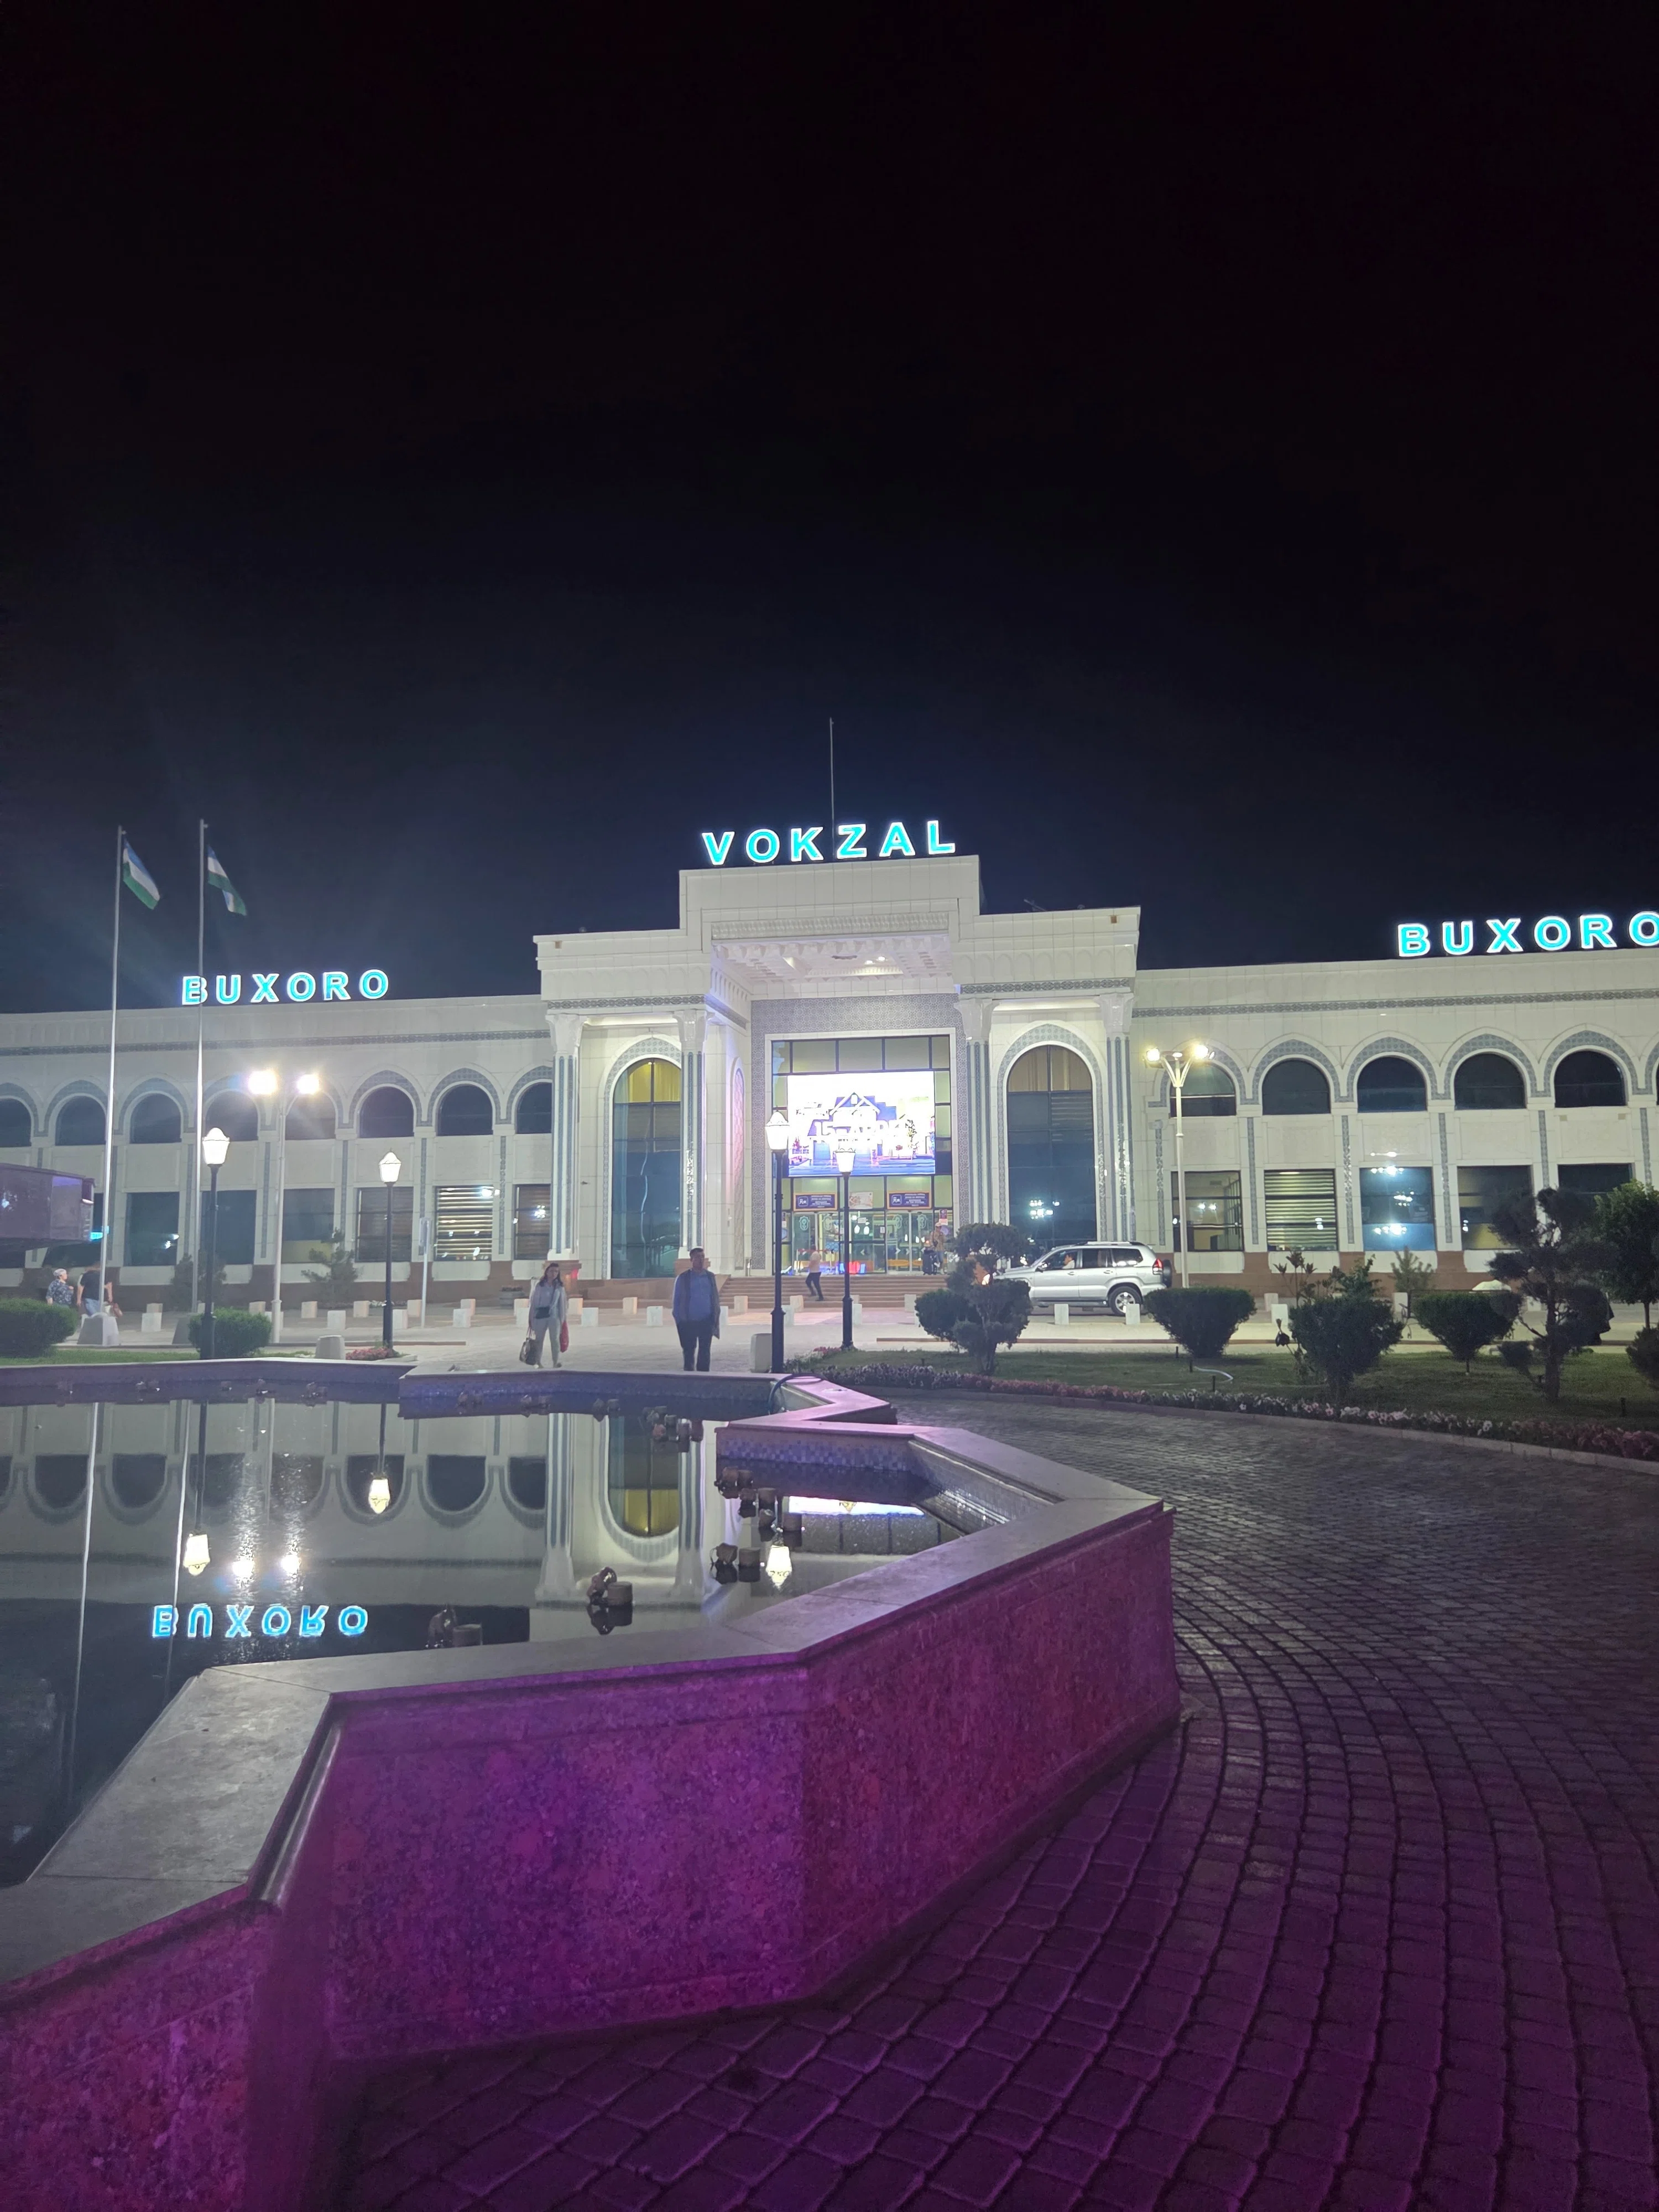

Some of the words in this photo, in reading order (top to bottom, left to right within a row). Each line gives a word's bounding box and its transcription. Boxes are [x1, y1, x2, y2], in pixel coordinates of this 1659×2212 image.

[701, 820, 956, 865] VOKZAL
[1397, 911, 1659, 957] BUXORO
[181, 969, 389, 1005] BUXORO
